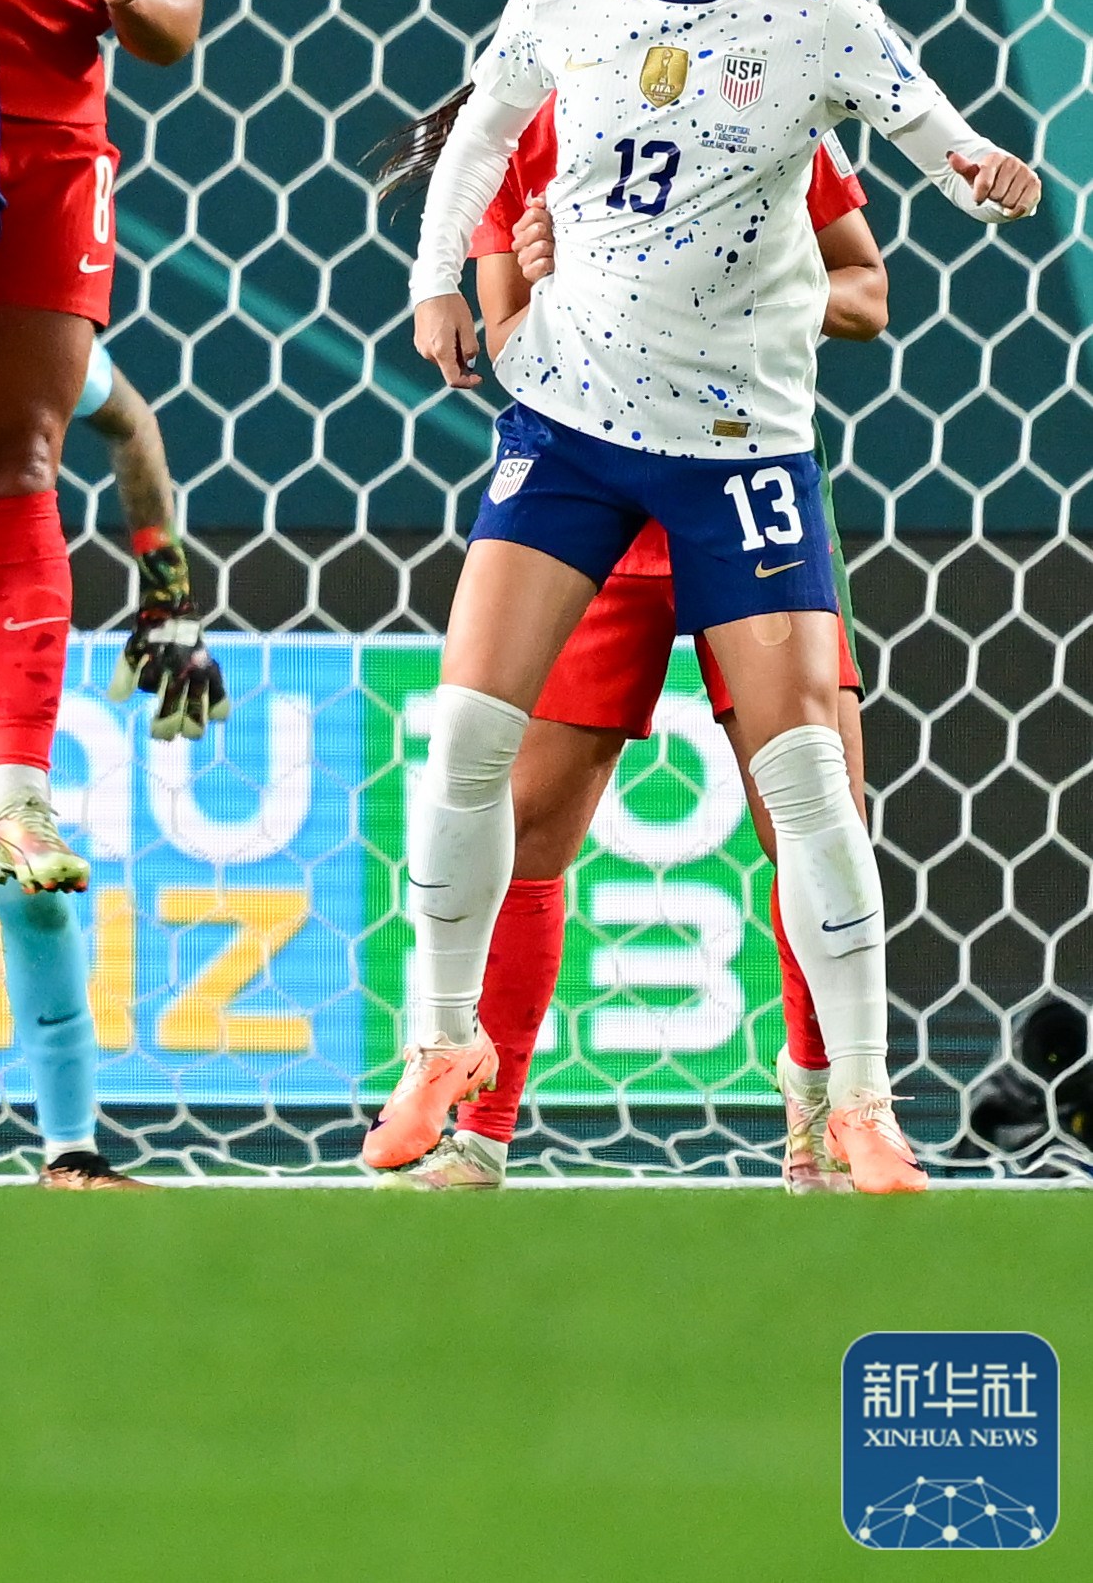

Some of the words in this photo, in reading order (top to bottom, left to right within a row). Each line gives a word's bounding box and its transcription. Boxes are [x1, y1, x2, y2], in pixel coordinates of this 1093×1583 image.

[650, 83, 672, 93] FIFA
[726, 58, 763, 80] USA
[92, 154, 112, 244] 8
[605, 137, 681, 217] 13
[499, 461, 530, 478] USA
[723, 464, 804, 554] 13
